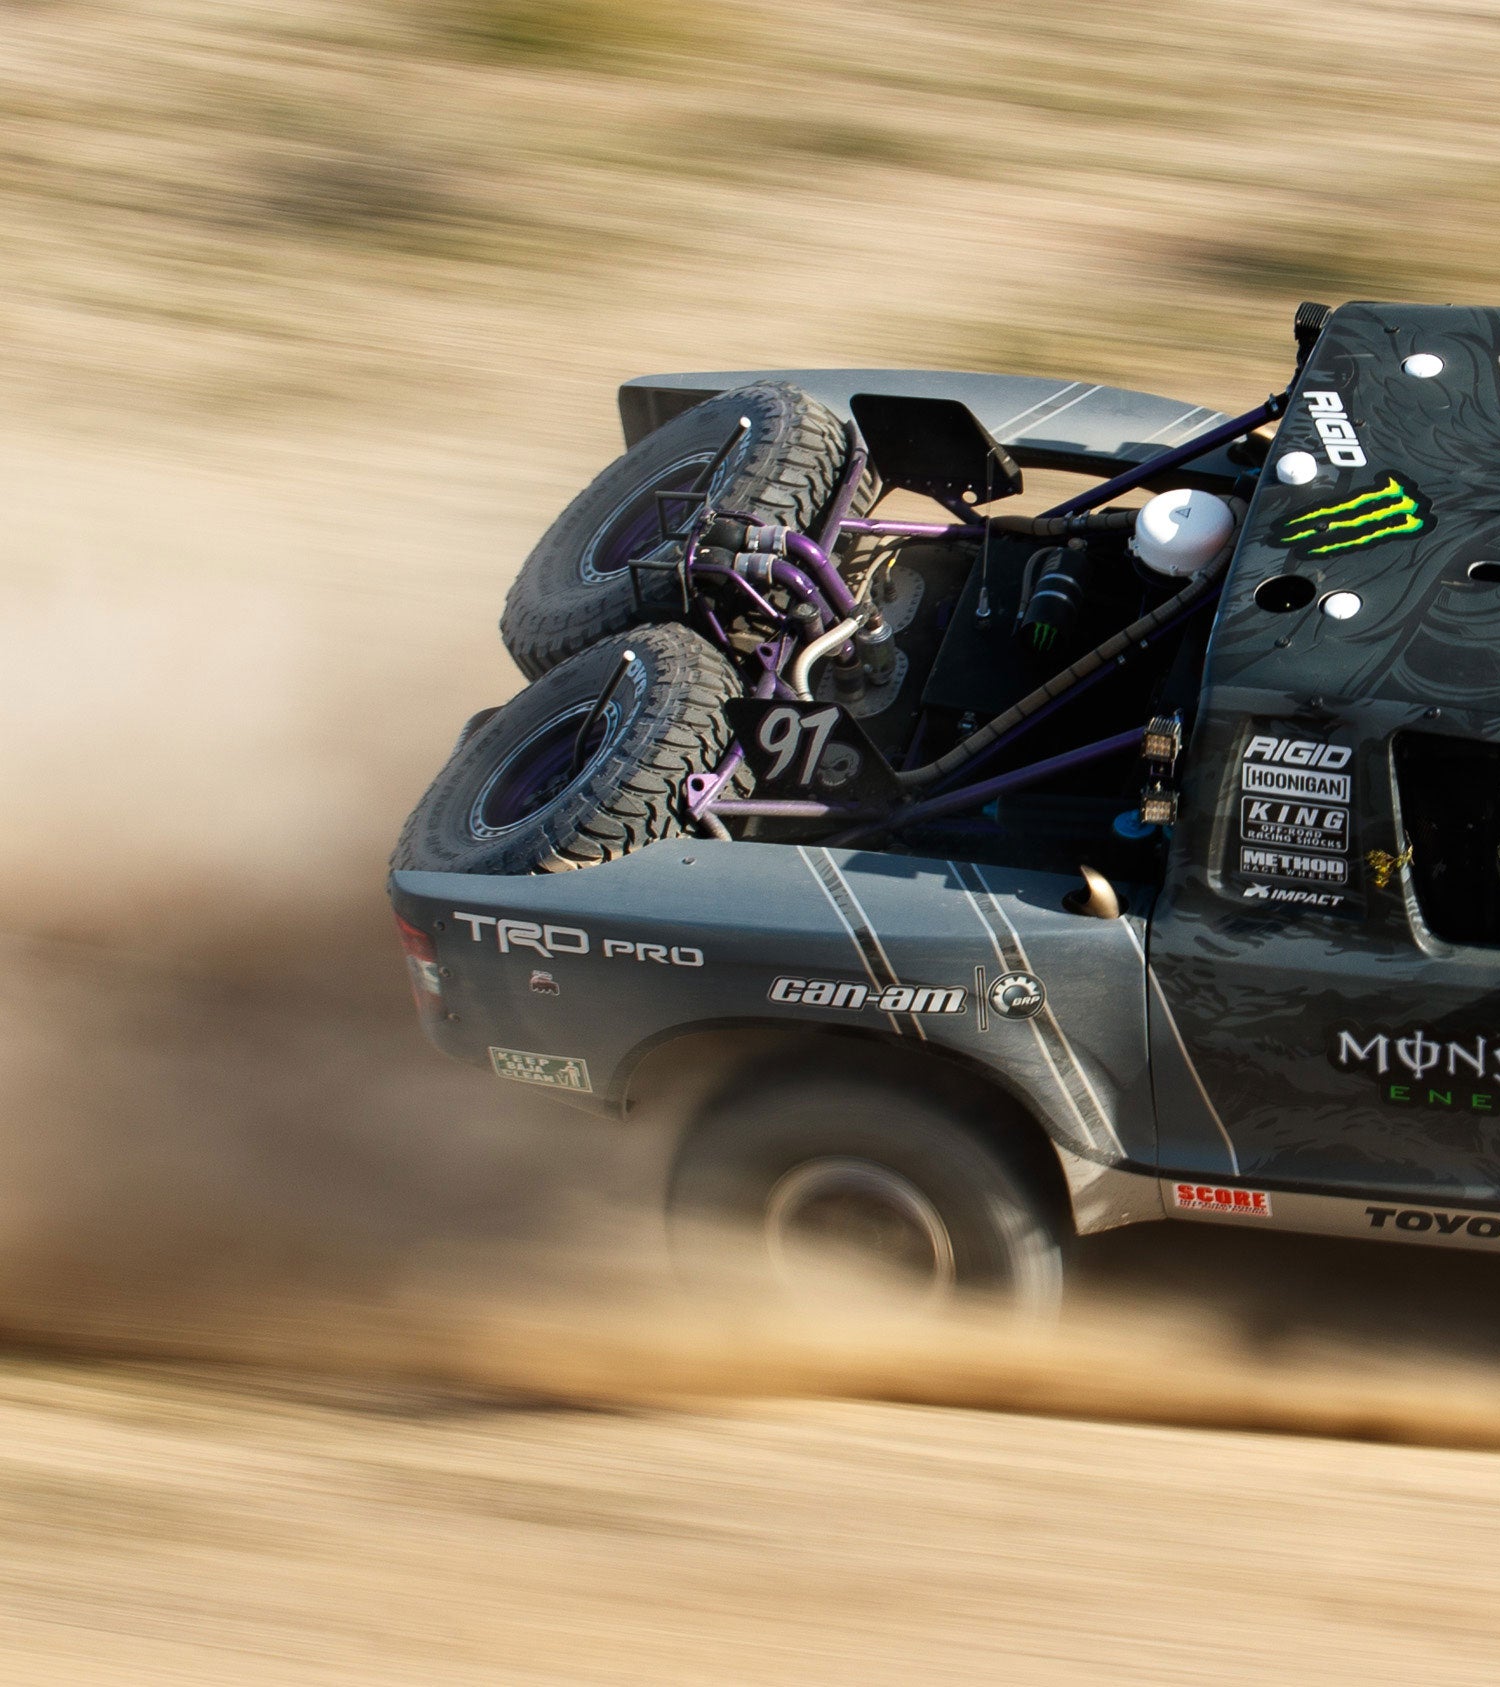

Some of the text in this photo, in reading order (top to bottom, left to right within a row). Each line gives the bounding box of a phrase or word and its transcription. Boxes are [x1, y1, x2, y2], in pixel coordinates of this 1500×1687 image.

[1303, 391, 1367, 467] RIGID
[759, 706, 840, 785] 91
[1243, 735, 1352, 769] RIGID
[1248, 801, 1345, 830] KING
[1248, 830, 1342, 849] RACING SHOCKS
[1261, 825, 1322, 838] OFF-ROAD
[1243, 850, 1344, 874] METHOD
[1243, 864, 1344, 882] RACE WHEELS
[453, 911, 704, 967] TRD PRO
[768, 976, 968, 1015] can-am
[498, 1052, 549, 1066] KEEP
[502, 1069, 554, 1083] CLEAN
[1178, 1184, 1267, 1208] SCORE
